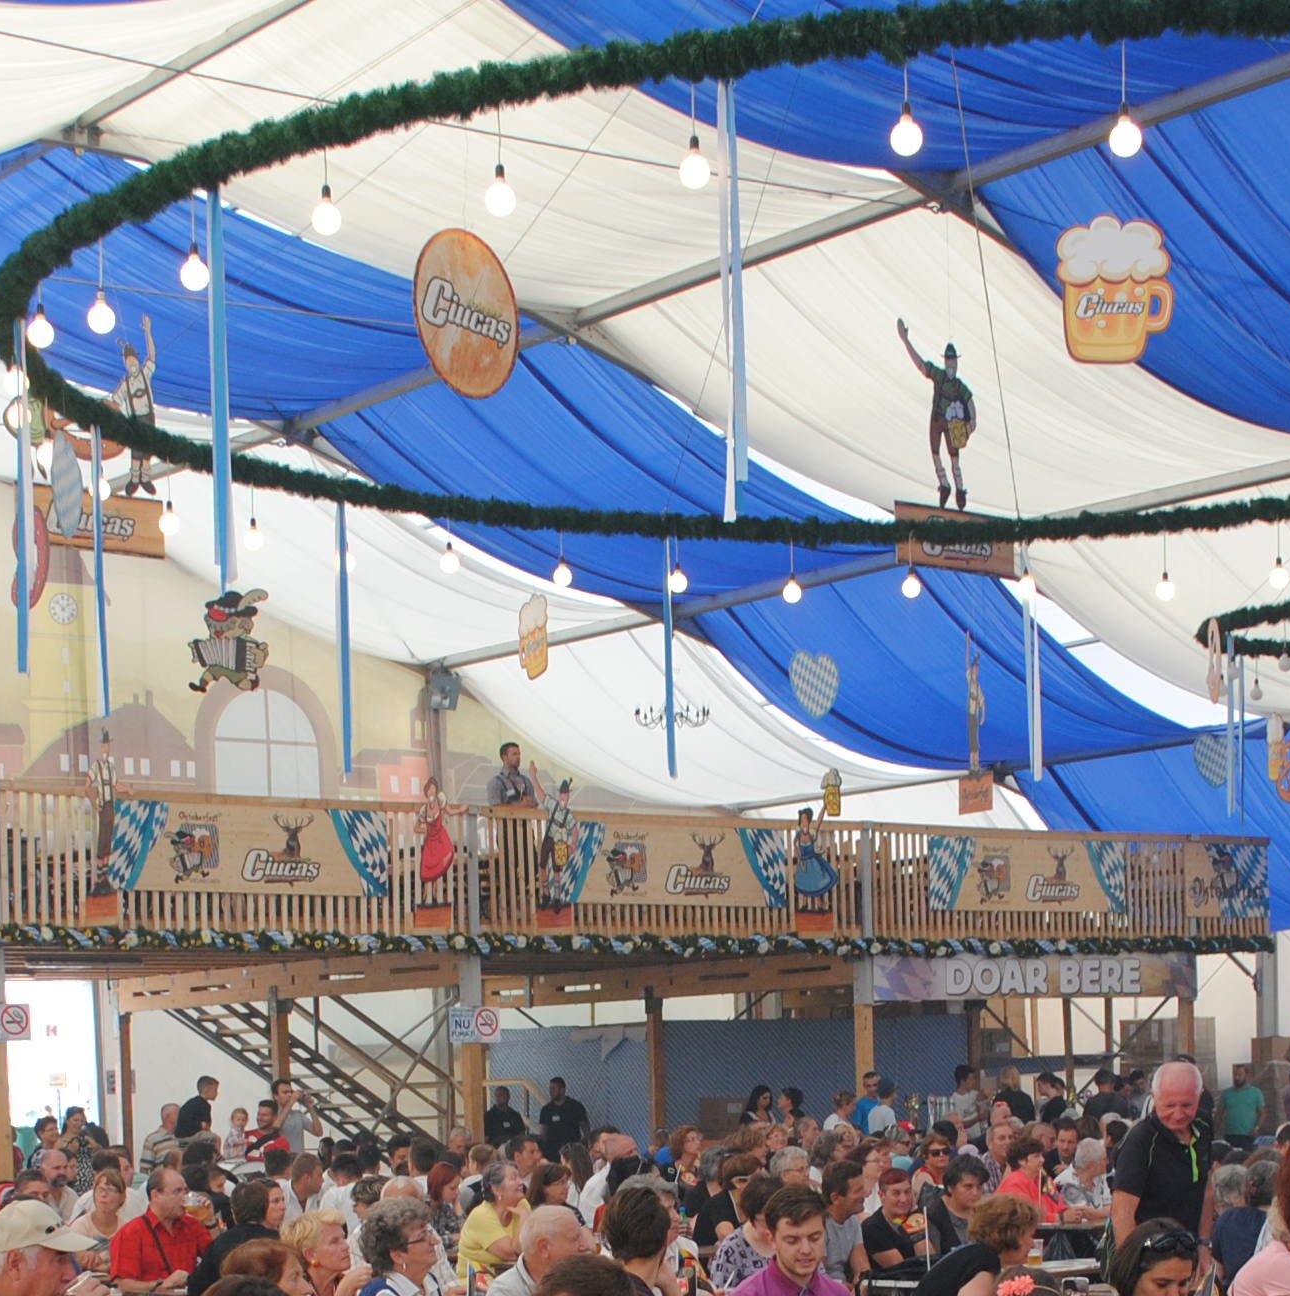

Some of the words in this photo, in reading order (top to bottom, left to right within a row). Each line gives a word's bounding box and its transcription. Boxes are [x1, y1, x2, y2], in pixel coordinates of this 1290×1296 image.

[946, 958, 1049, 996] DOAR
[1060, 958, 1141, 995] BERE
[454, 1019, 470, 1030] NU
